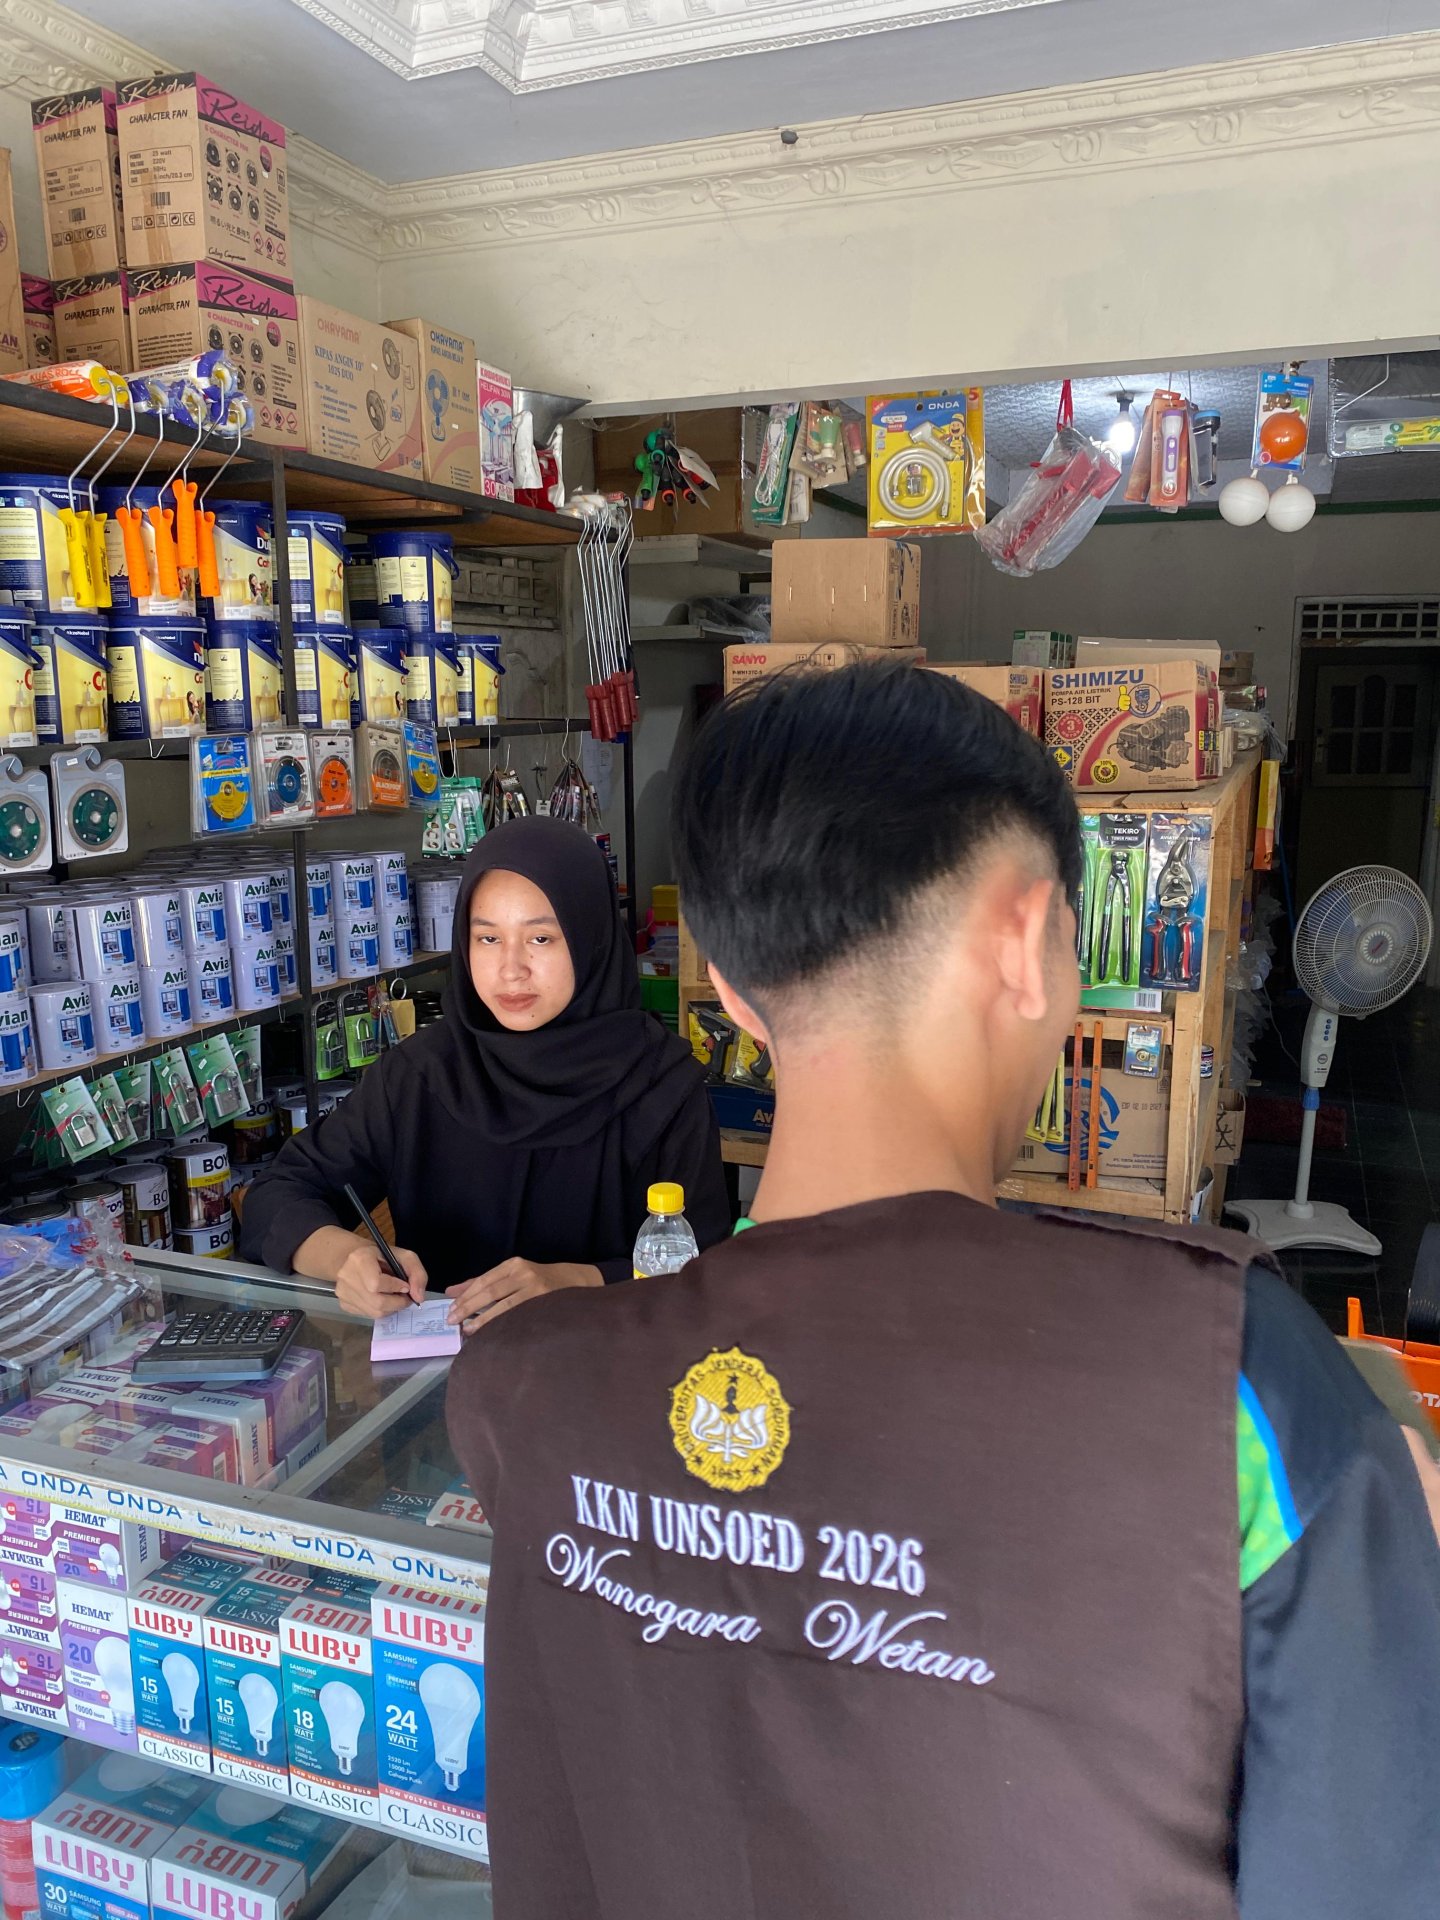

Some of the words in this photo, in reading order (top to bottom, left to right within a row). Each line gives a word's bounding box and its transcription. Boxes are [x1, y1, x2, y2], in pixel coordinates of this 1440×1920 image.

[122, 79, 194, 104] Reida
[37, 96, 102, 125] Reida
[130, 111, 170, 124] CHARACTER
[172, 109, 188, 118] FAN
[201, 88, 277, 143] Reida
[44, 128, 82, 143] CHARACTER
[83, 125, 97, 137] FAN
[57, 277, 120, 302] Reida
[135, 270, 195, 296] Reida
[204, 276, 287, 320] Reida
[64, 309, 100, 321] CHARACTER
[101, 306, 115, 316] FAN
[138, 303, 175, 316] CHARACTER
[176, 300, 190, 310] FAN
[317, 318, 360, 344] OKAYAMA
[430, 330, 464, 352] OKAYAMA
[928, 401, 960, 411] ONDA
[484, 479, 496, 497] 30
[732, 655, 767, 666] SANYO
[1051, 668, 1144, 690] SHIMIZU
[1086, 687, 1111, 695] LISTRIK
[1051, 696, 1083, 706] PS-128
[1085, 695, 1102, 705] BIT
[1066, 721, 1076, 732] 3
[1113, 827, 1140, 835] TEKIRO
[197, 889, 223, 905] Avia
[245, 882, 270, 897] Avia
[103, 906, 131, 924] Avia
[202, 956, 229, 973] Avia
[163, 968, 188, 985] Avia
[110, 980, 139, 998] Avia
[62, 992, 90, 1011] Avia
[0, 1009, 29, 1026] vian
[247, 1101, 275, 1117] BOY
[203, 1153, 228, 1173] BOY
[79, 1371, 121, 1383] HEMAT
[55, 1385, 100, 1399] HEMAT
[122, 1390, 168, 1403] HEMAT
[199, 1395, 240, 1408] HEMAT
[250, 1423, 260, 1465] HEMAT
[21, 1469, 94, 1500] ONDA
[107, 1488, 183, 1520] ONDA
[65, 1508, 107, 1528] HEMAT
[2, 1534, 38, 1549] PREMIERE
[63, 1529, 101, 1545] PREMIERE
[138, 1523, 148, 1563] HEMA
[571, 1474, 640, 1542] KKN
[650, 1495, 804, 1574] UNSOED
[816, 1526, 926, 1597] 2026
[1, 1549, 45, 1568] HEMAT
[178, 1553, 243, 1575] CLASSIC
[63, 1562, 80, 1576] 20
[30, 1575, 48, 1592] 15
[206, 1579, 224, 1590] 15
[236, 1586, 253, 1596] 15
[138, 1585, 206, 1611] LUBY
[8, 1610, 44, 1625] PREMIERE
[71, 1603, 111, 1622] HEMAT
[546, 1533, 762, 1645] Wanogara
[804, 1599, 995, 1686] Wetan
[67, 1622, 101, 1635] PREMIERE
[134, 1607, 193, 1638] LUBY
[292, 1603, 373, 1636] LUBY
[7, 1624, 50, 1643] HEMAT
[383, 1607, 474, 1653] LUBY
[136, 1638, 159, 1649] SAMSUNG
[209, 1626, 271, 1659] LUBY
[289, 1628, 361, 1665] LUBY
[36, 1653, 54, 1669] 15
[69, 1642, 92, 1665] 20
[383, 1650, 418, 1665] SAMSUNG
[212, 1658, 236, 1669] SAMSUNG
[289, 1663, 317, 1676] SAMSUNG
[140, 1676, 158, 1694] 15
[293, 1684, 316, 1695] PREMIUM
[387, 1675, 416, 1688] PREMIUM
[16, 1687, 51, 1702] PREMIERE
[141, 1693, 159, 1703] WATT
[15, 1701, 57, 1720] HEMAT
[74, 1703, 93, 1716] 10000
[216, 1697, 234, 1715] 15
[217, 1714, 235, 1725] WATT
[293, 1708, 314, 1729] 18
[385, 1704, 418, 1735] 24
[294, 1728, 314, 1740] WATT
[387, 1733, 418, 1748] WATT
[143, 1739, 205, 1768] CLASSIC
[219, 1762, 282, 1790] CLASSIC
[293, 1768, 306, 1777] LOW
[338, 1782, 351, 1791] LED
[353, 1786, 372, 1796] BULB
[295, 1781, 374, 1815] CLASSIC
[384, 1787, 401, 1797] LOW
[442, 1804, 457, 1814] LED
[460, 1809, 482, 1820] BULB
[54, 1803, 154, 1850] LUBY
[387, 1803, 484, 1846] CLASSIC
[45, 1835, 135, 1891] LUBY
[175, 1838, 281, 1887] LUBY
[44, 1882, 68, 1904] 30
[69, 1890, 102, 1907] SAMSUNG
[166, 1872, 263, 1920] LUBY
[46, 1901, 68, 1915] WATT
